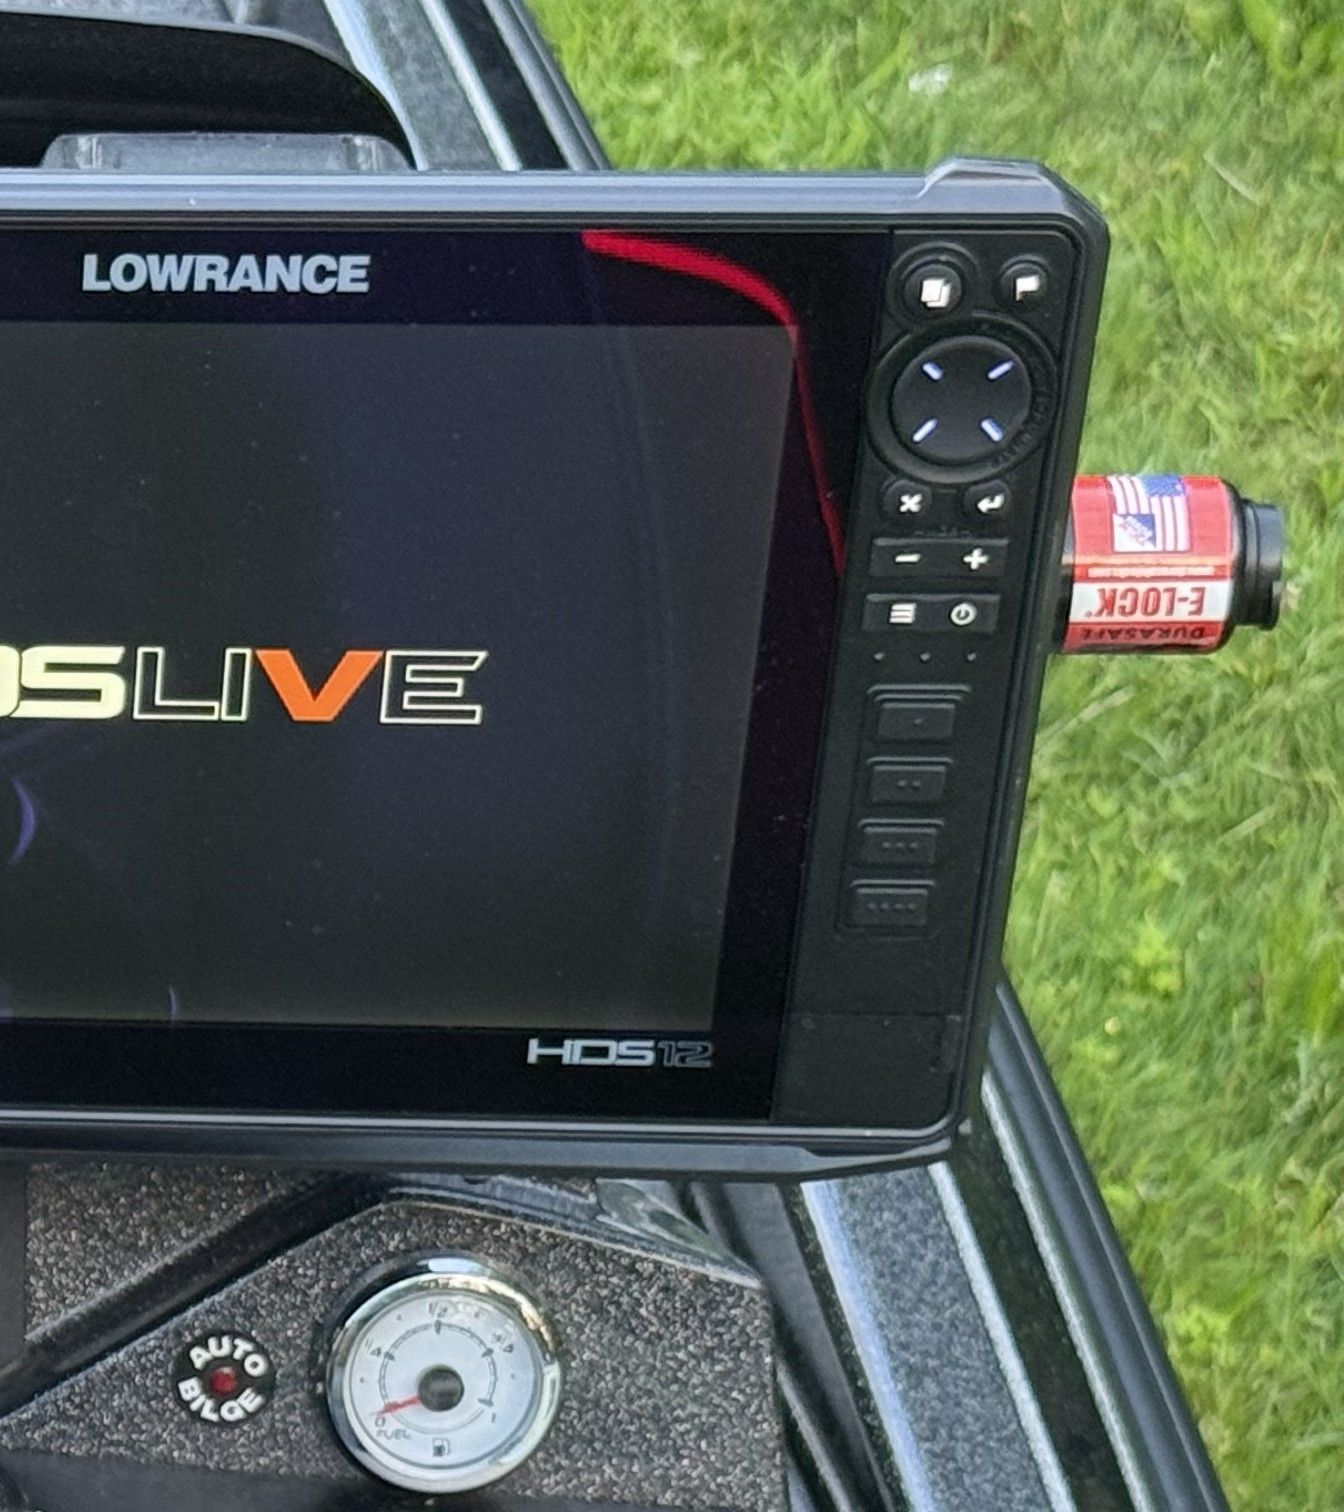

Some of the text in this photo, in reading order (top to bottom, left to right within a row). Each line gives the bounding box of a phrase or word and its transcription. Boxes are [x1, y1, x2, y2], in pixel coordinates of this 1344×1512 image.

[81, 253, 371, 293] LOWRANCE
[189, 1335, 268, 1377] AUTO
[178, 1376, 265, 1422] BILGE
[376, 1428, 411, 1441] FUEL
